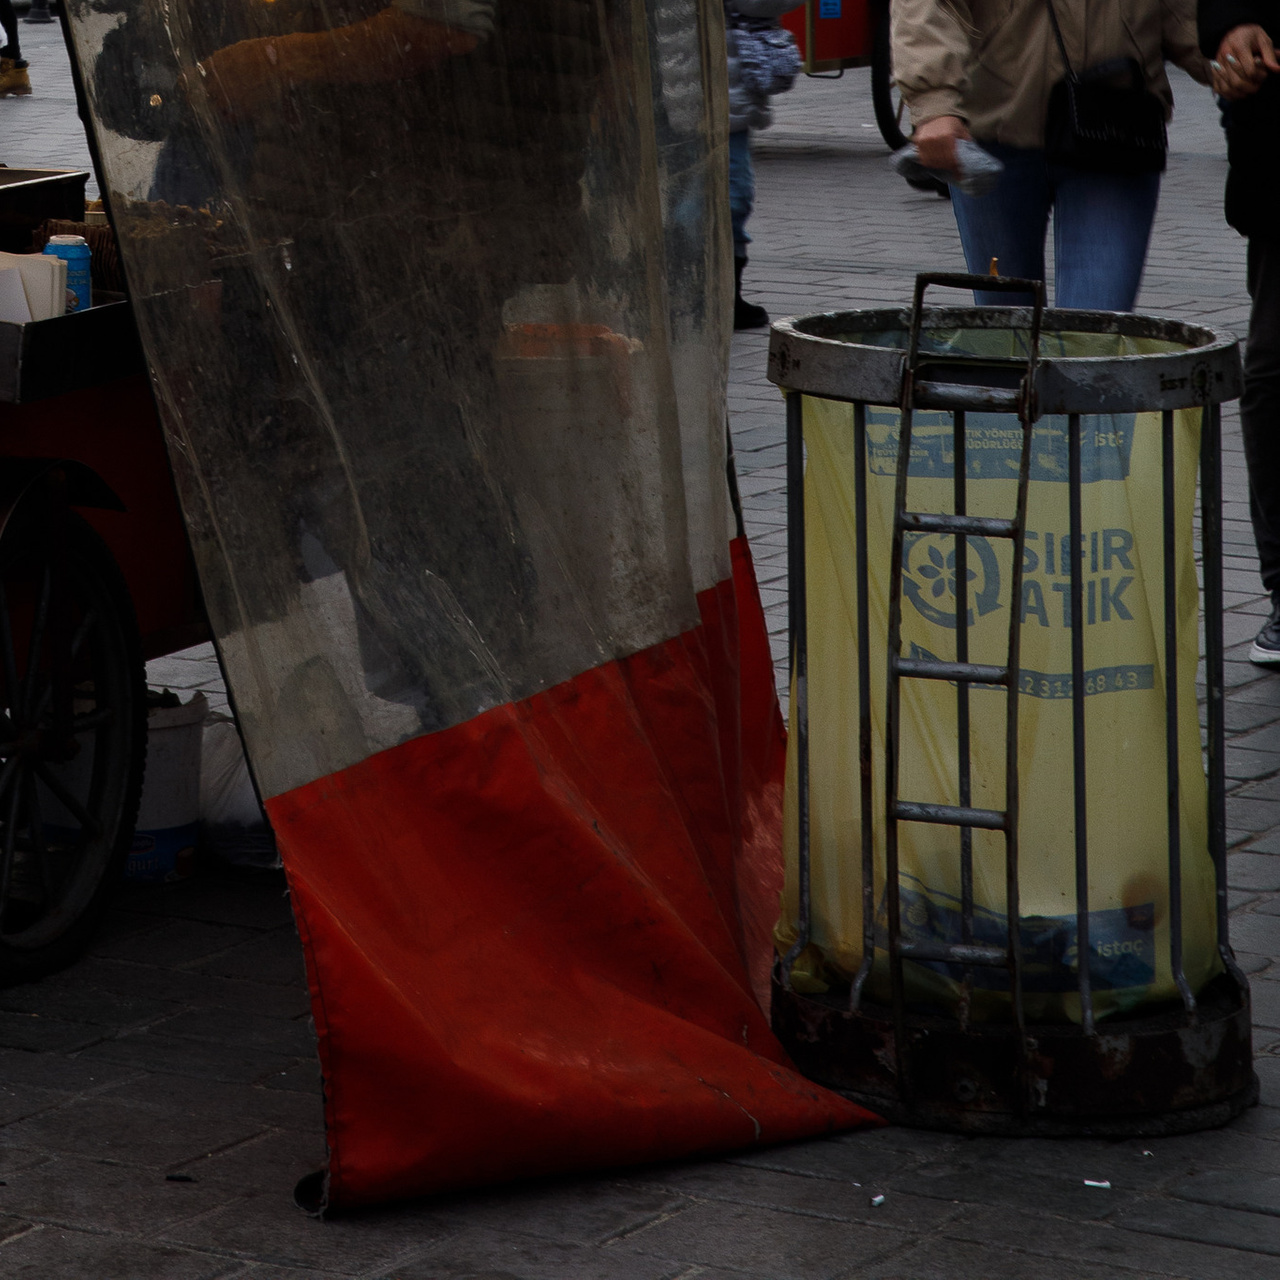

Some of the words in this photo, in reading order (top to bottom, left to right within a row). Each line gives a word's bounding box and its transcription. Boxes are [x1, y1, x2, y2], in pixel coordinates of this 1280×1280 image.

[1021, 528, 1135, 576] SIFIR
[1020, 577, 1135, 628] ATIK
[1097, 938, 1144, 958] istaç
